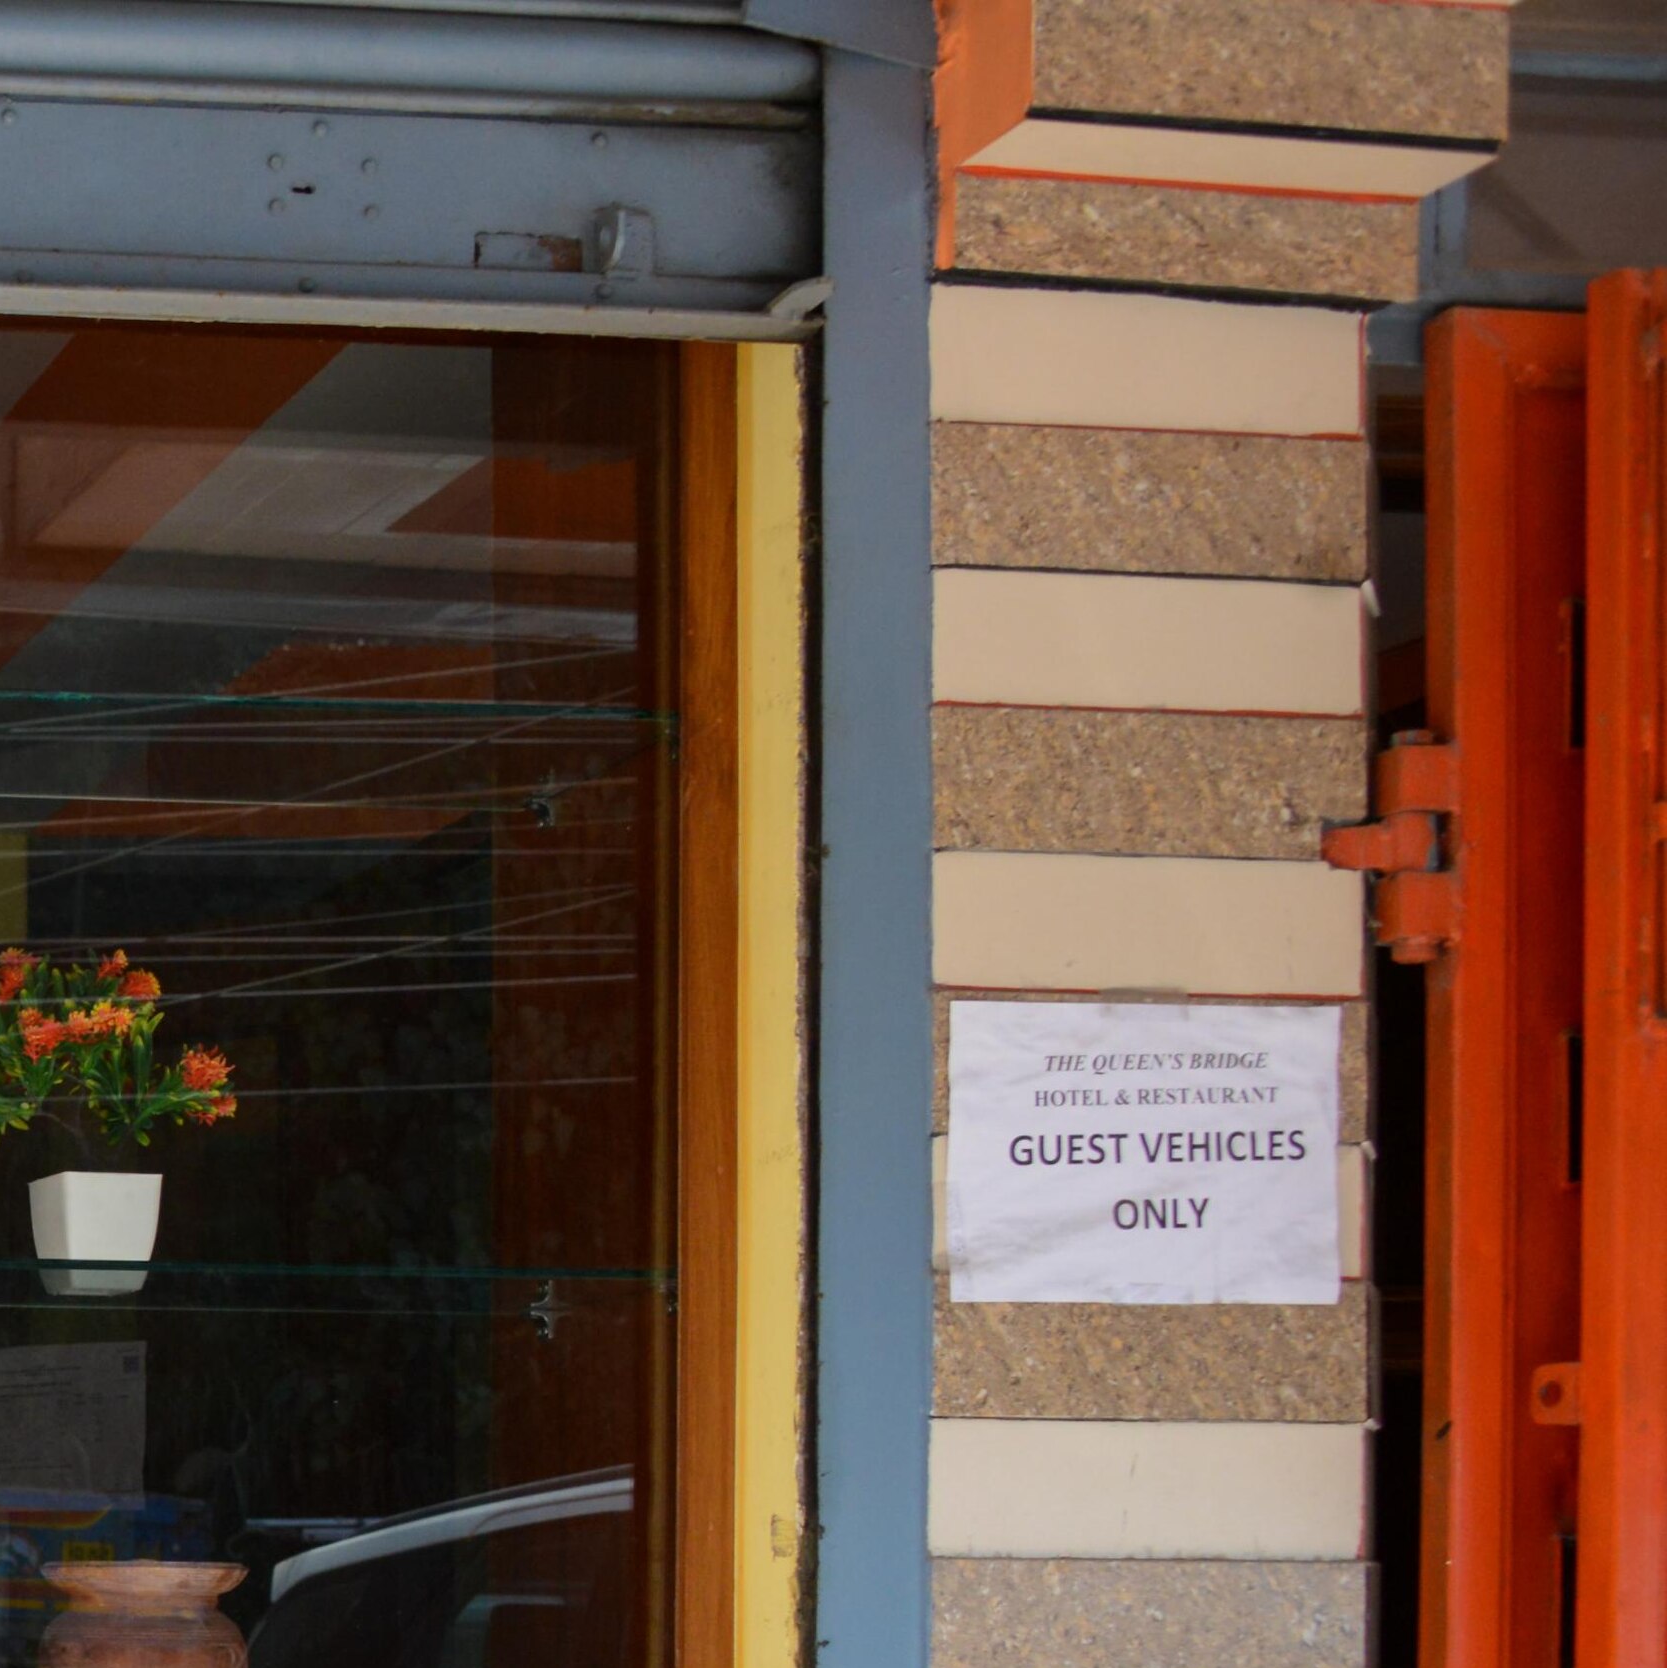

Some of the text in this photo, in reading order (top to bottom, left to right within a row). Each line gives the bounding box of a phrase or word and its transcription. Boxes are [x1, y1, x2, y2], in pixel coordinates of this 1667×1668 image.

[1044, 1051, 1269, 1076] THE QUEEN'S BRIDGE
[1034, 1086, 1279, 1108] HOTEL & RESTAURANT
[1008, 1129, 1307, 1167] GUEST VEHICLES
[1111, 1197, 1210, 1231] ONLY
